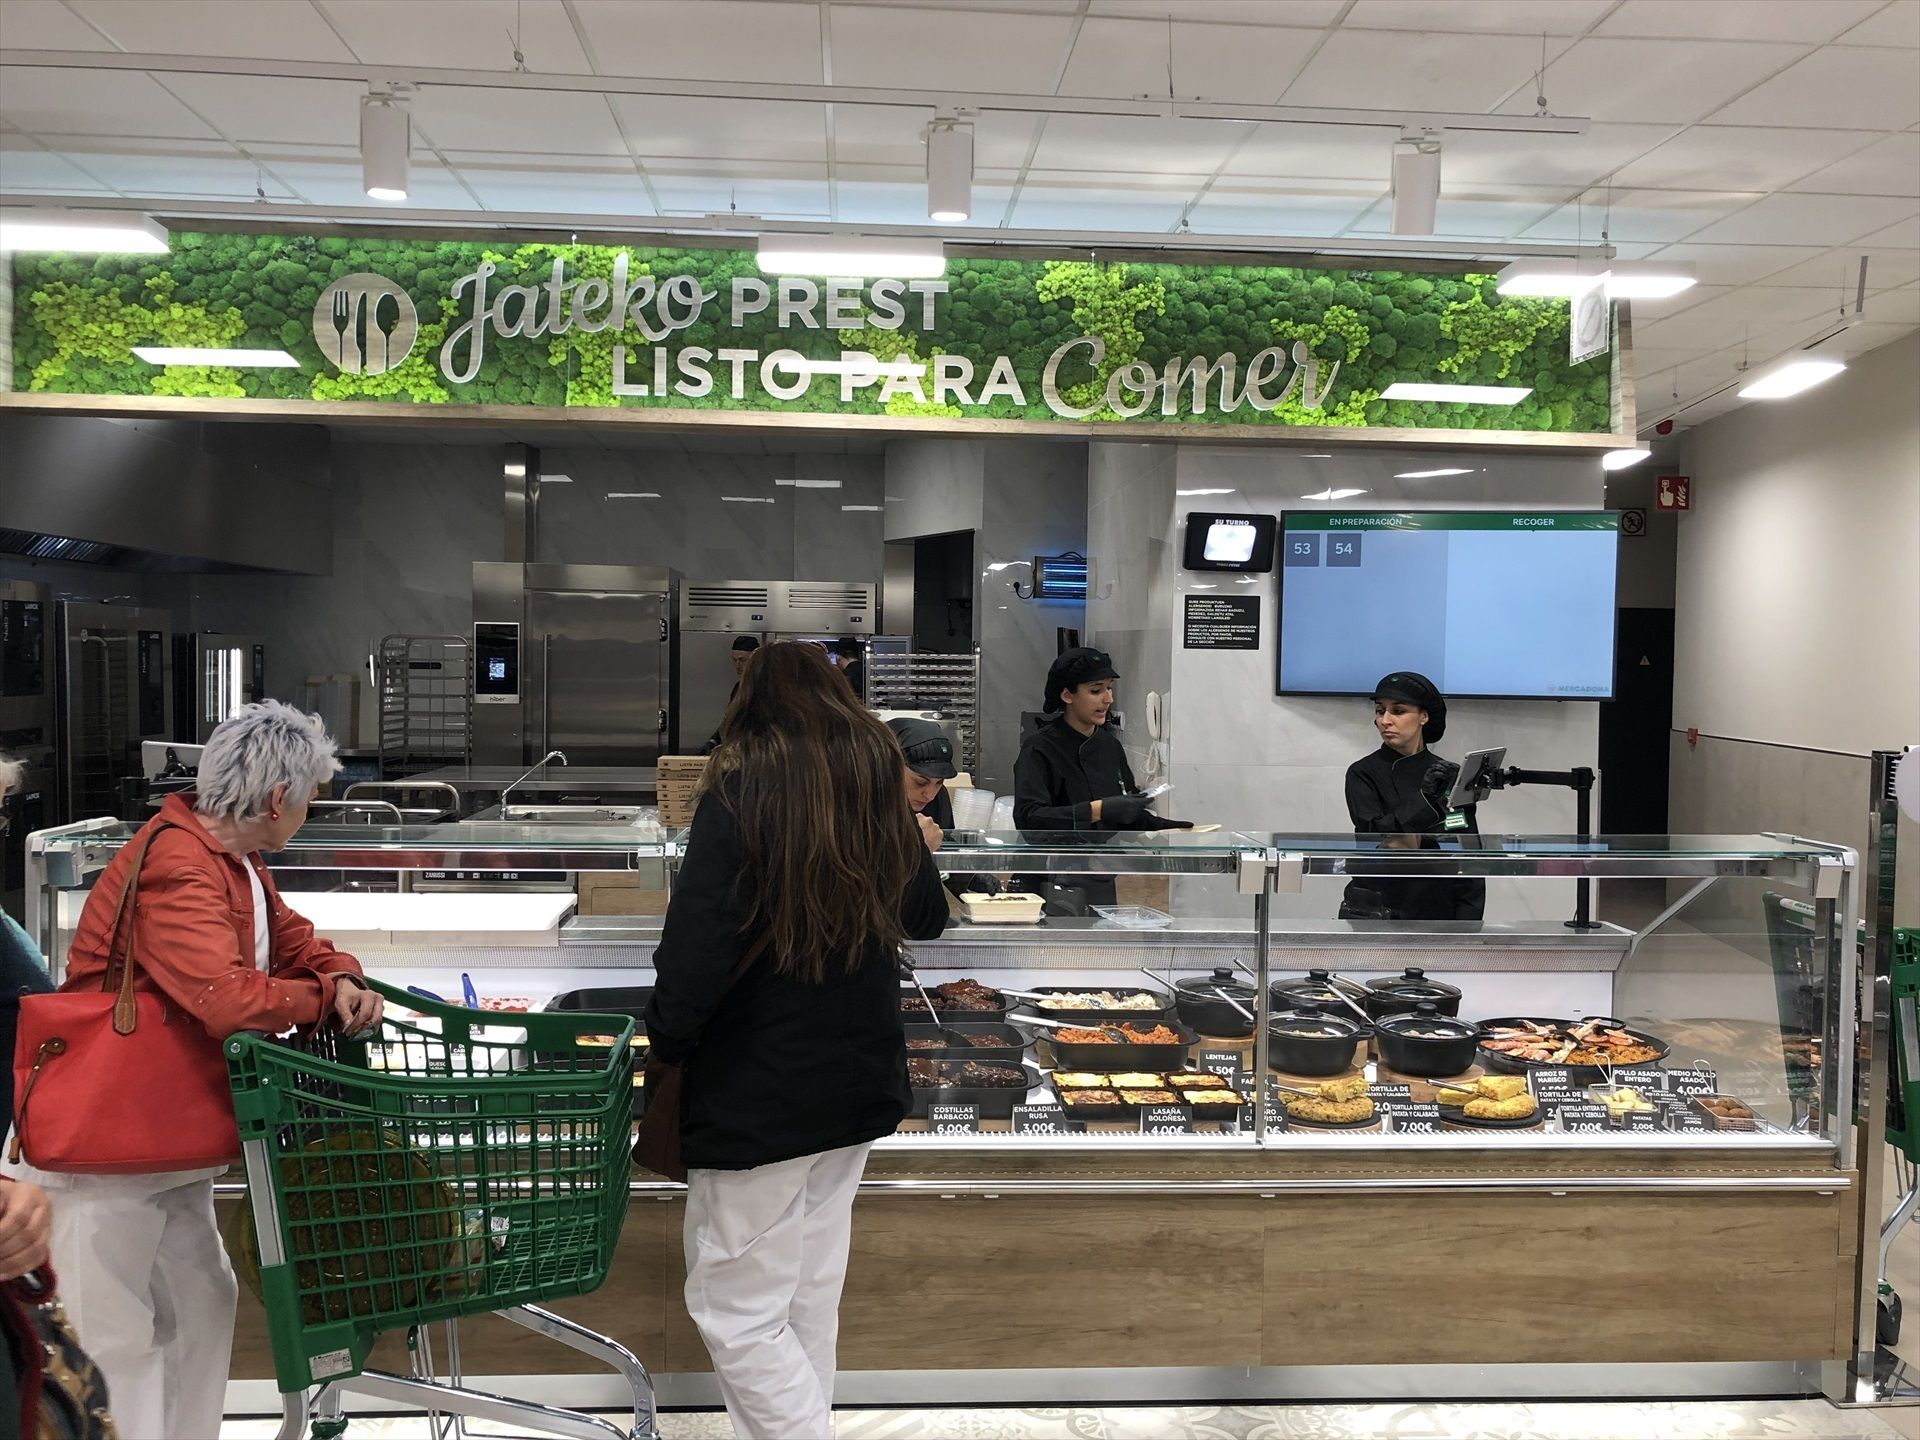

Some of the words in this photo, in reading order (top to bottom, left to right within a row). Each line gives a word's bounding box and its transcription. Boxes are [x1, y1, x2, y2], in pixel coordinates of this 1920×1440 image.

[440, 251, 718, 384] Jateko
[731, 277, 949, 330] PREST
[612, 345, 811, 400] LISTO
[840, 350, 1027, 406] PARA
[1042, 336, 1340, 418] Comer
[1329, 518, 1341, 526] EN
[1512, 518, 1555, 526] RECOGER
[1294, 543, 1311, 554] 53
[1335, 543, 1353, 554] 54
[1014, 1105, 1063, 1113] ENSALADILLA
[1152, 1107, 1182, 1115] LASAÑA
[1148, 1114, 1187, 1122] BOLOÑESA
